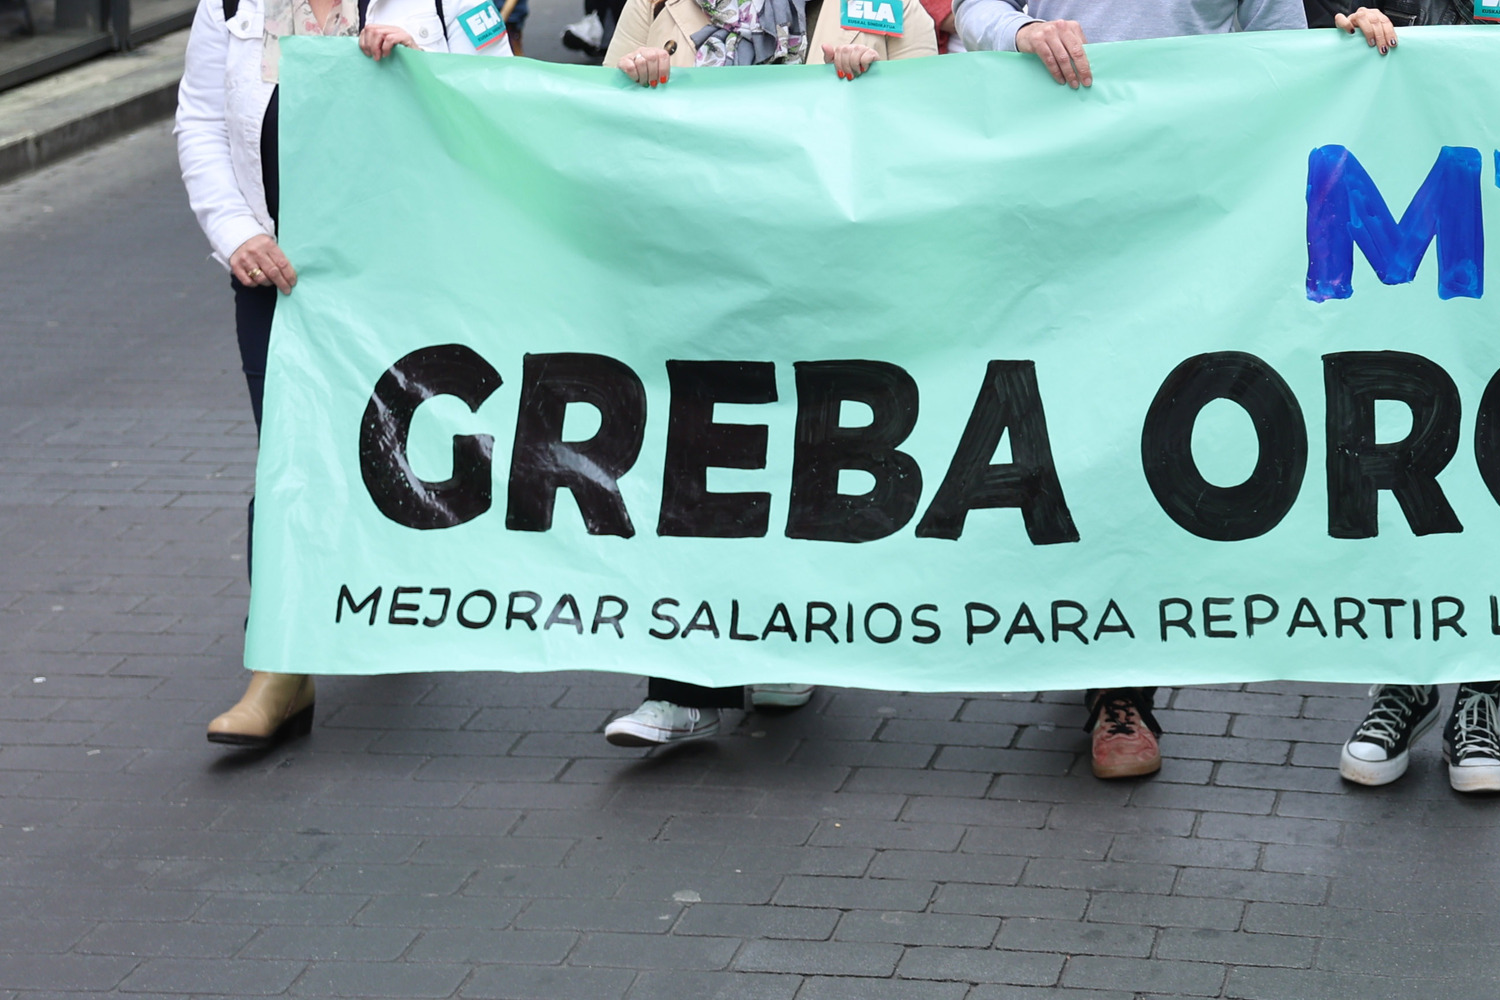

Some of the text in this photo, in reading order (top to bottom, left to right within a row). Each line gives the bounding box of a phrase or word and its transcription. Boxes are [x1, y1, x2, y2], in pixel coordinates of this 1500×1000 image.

[465, 5, 501, 37] ELA
[847, 0, 896, 24] ELA
[358, 343, 1081, 546] GREBA
[335, 583, 629, 641] MEJORAR
[648, 597, 941, 646] SALARIOS
[964, 598, 1136, 646] PARA
[1159, 593, 1468, 642] REPARTIR
